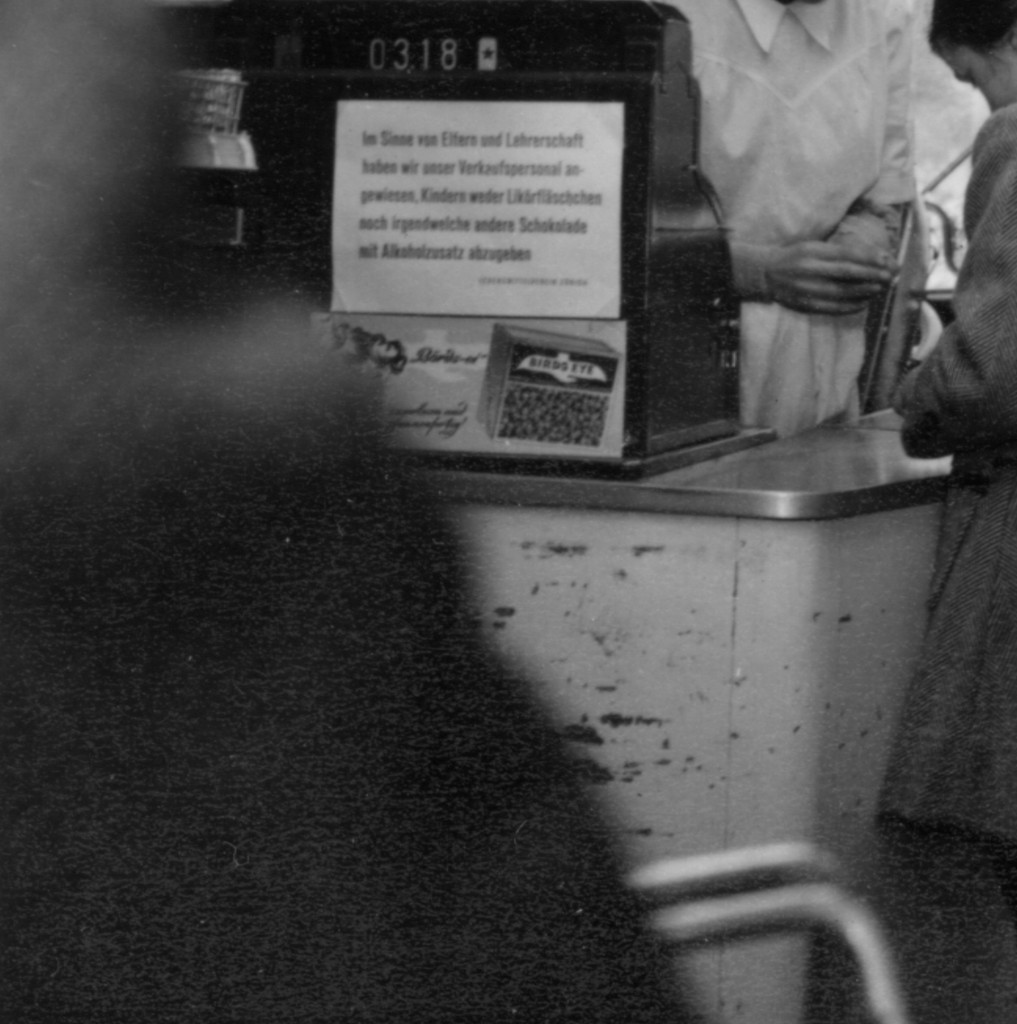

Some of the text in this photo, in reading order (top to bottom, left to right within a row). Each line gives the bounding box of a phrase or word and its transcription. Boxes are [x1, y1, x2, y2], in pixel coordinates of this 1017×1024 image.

[362, 131, 584, 148] Im Sinne von Eltern und Lehrerschaft
[362, 160, 585, 178] haben wir unser Verkaufspersonal an-
[421, 188, 467, 204] Kindern
[470, 189, 504, 204] weder
[359, 216, 588, 234] noch irgendwelche andere Schokolade
[359, 244, 532, 263] mit Alkoholzusatz abzugeben
[571, 363, 594, 376] EYE
